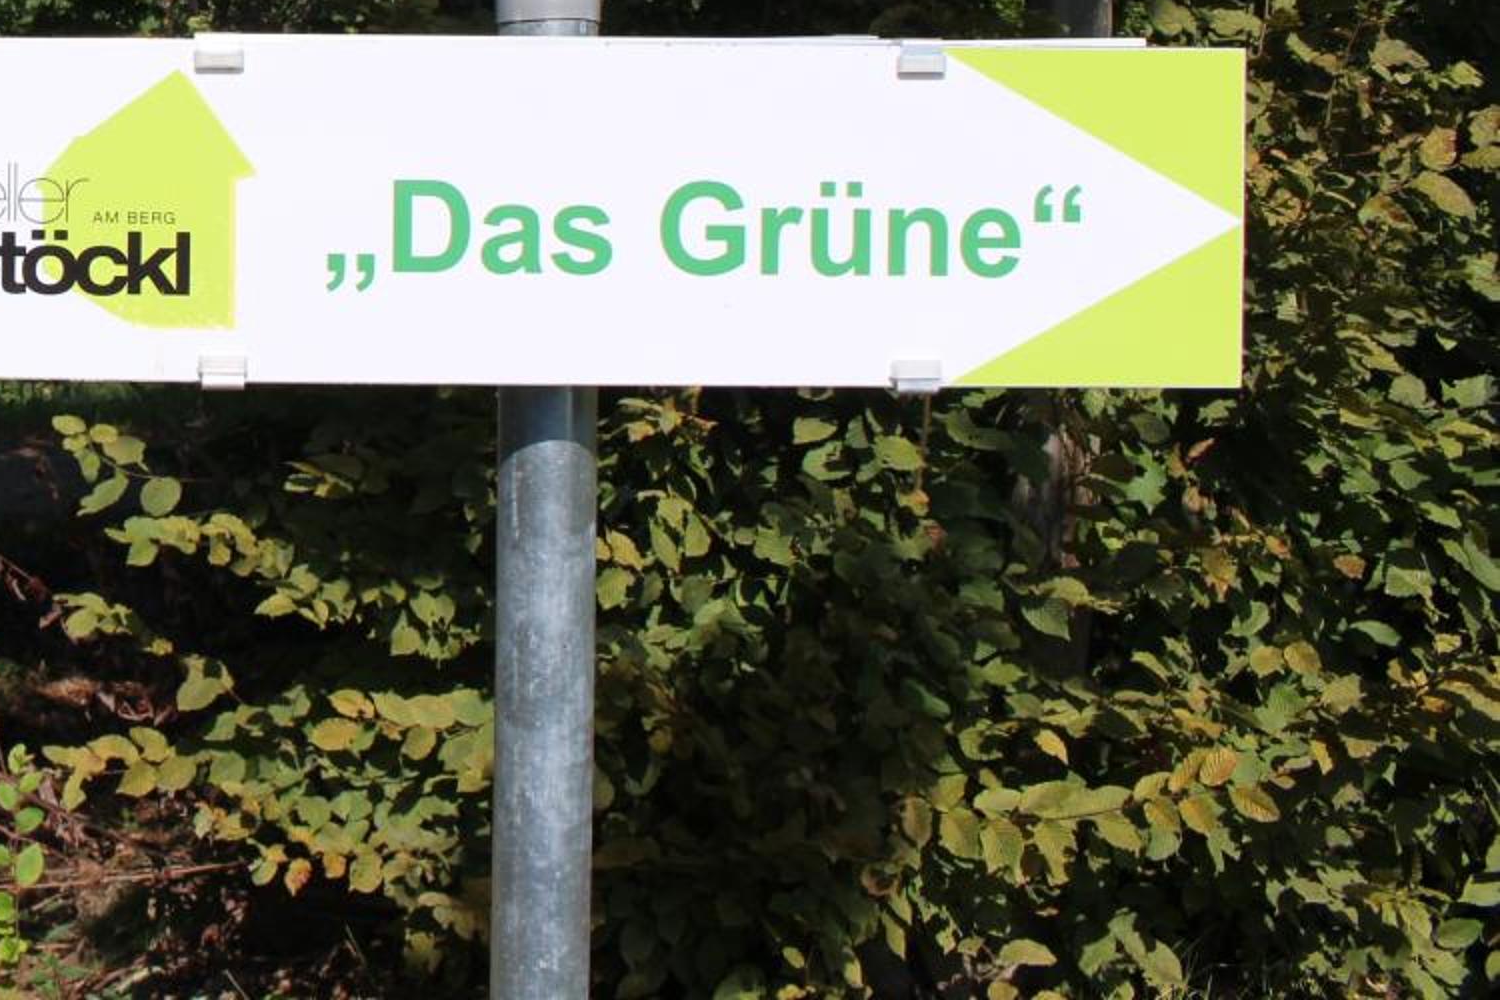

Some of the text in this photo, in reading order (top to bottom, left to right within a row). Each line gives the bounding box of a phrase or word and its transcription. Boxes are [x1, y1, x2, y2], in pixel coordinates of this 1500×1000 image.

[92, 211, 177, 225] AM BERG
[326, 179, 1082, 292] „Das Grüne“
